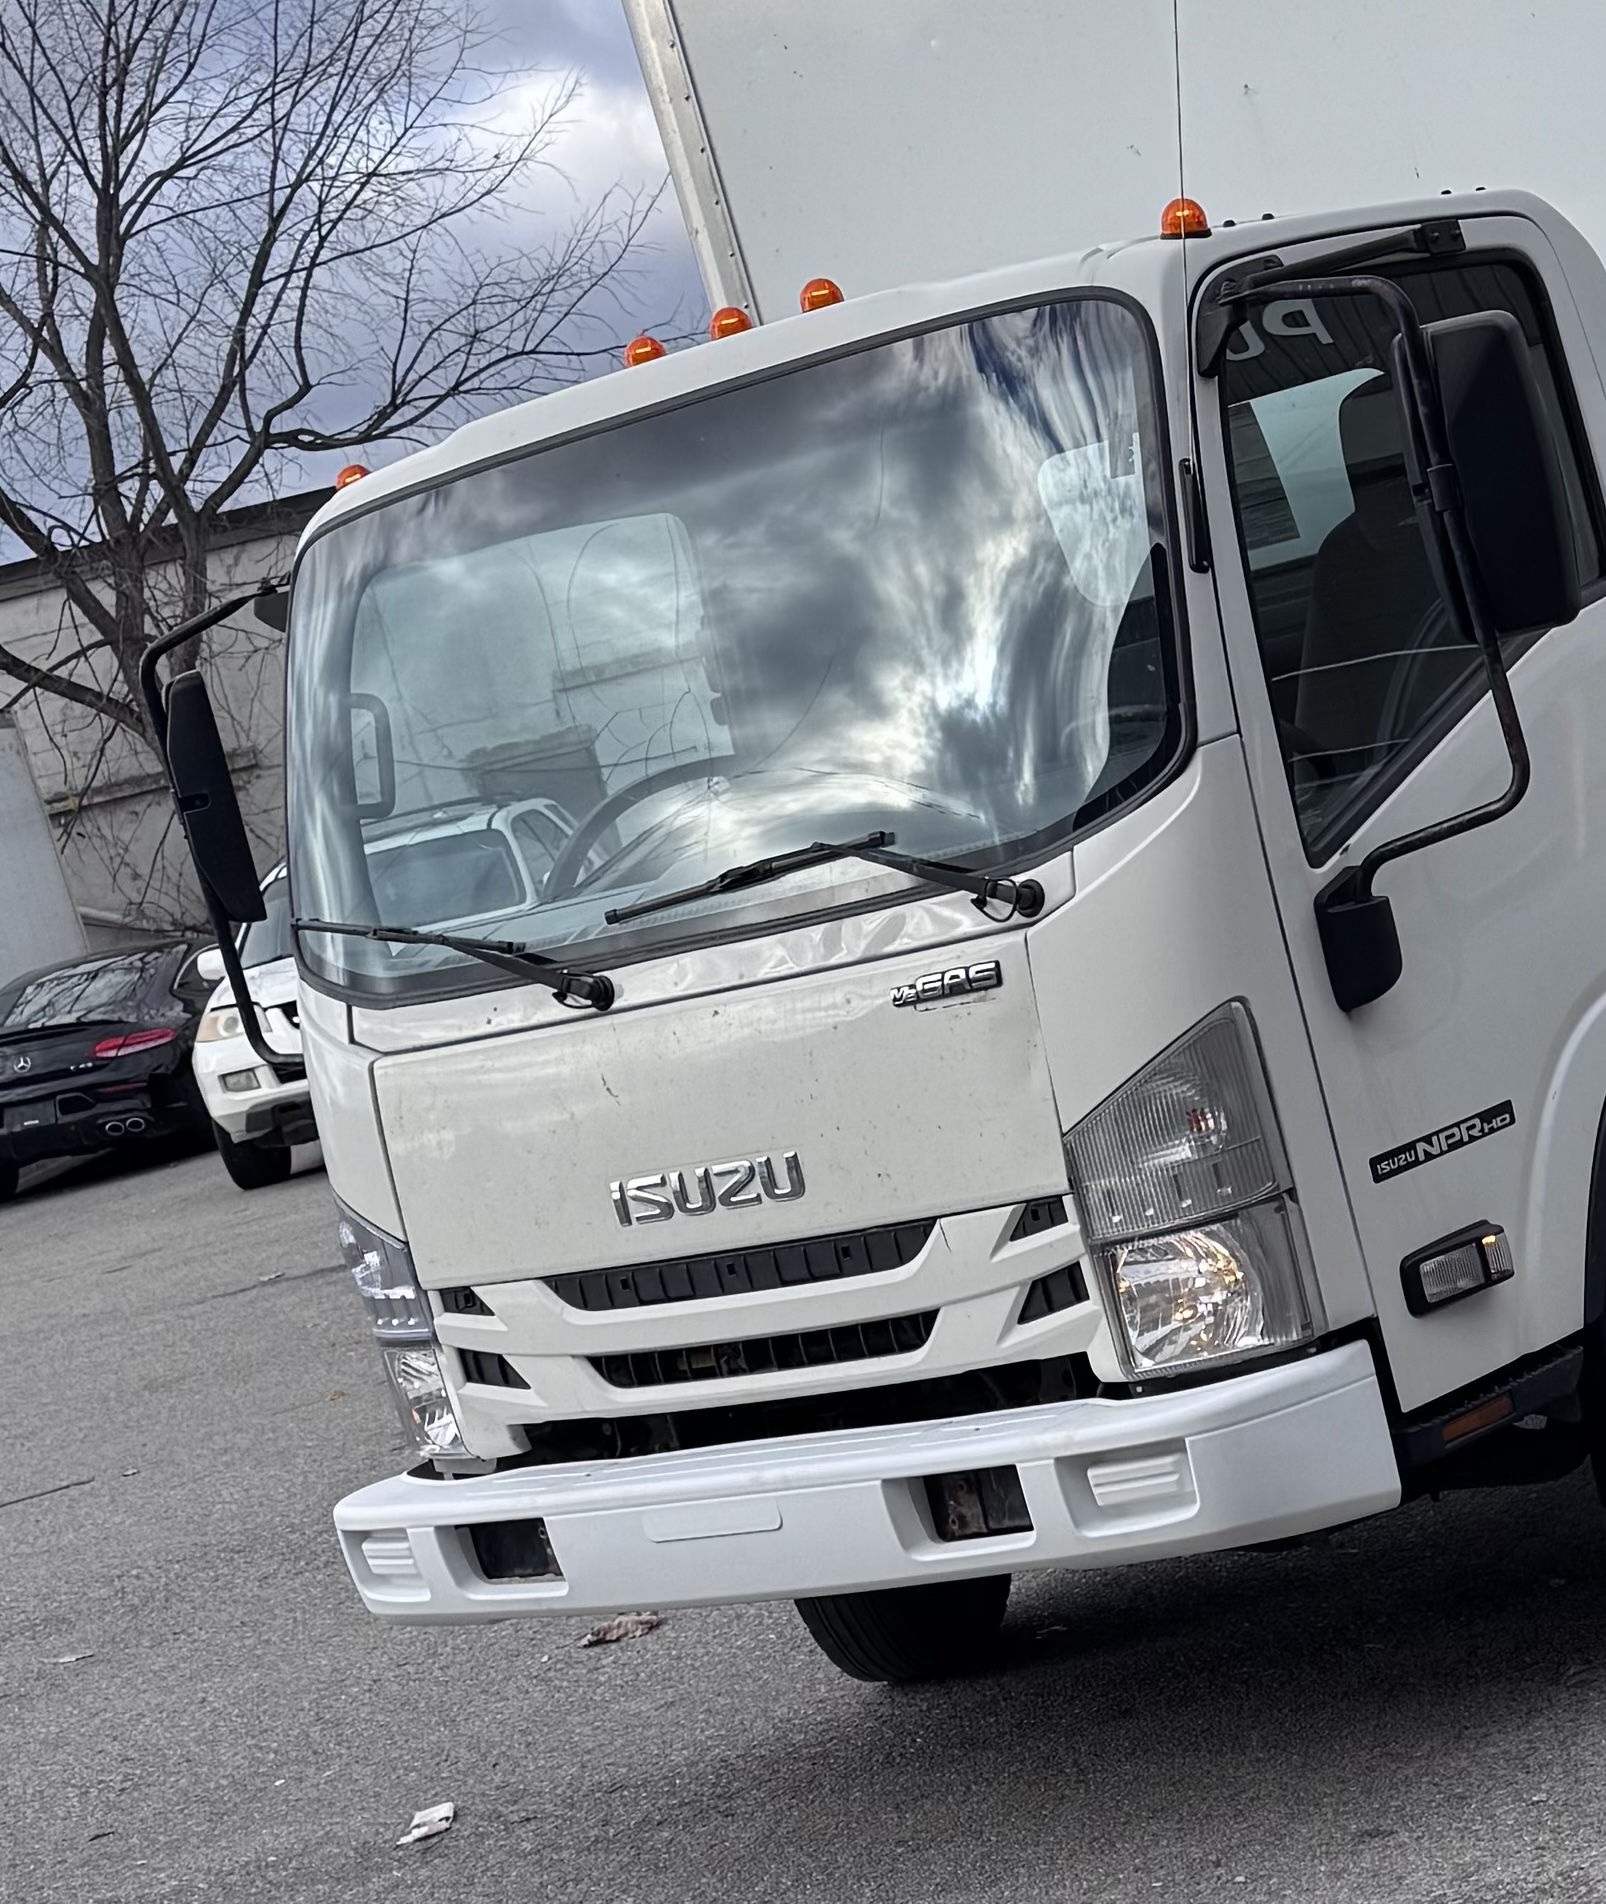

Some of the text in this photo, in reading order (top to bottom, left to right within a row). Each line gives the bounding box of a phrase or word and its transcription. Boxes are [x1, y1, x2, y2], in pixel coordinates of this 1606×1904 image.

[916, 962, 997, 998] GAS
[1377, 1113, 1511, 1175] ISUZU NPR HD
[609, 1150, 806, 1227] ISUZU
